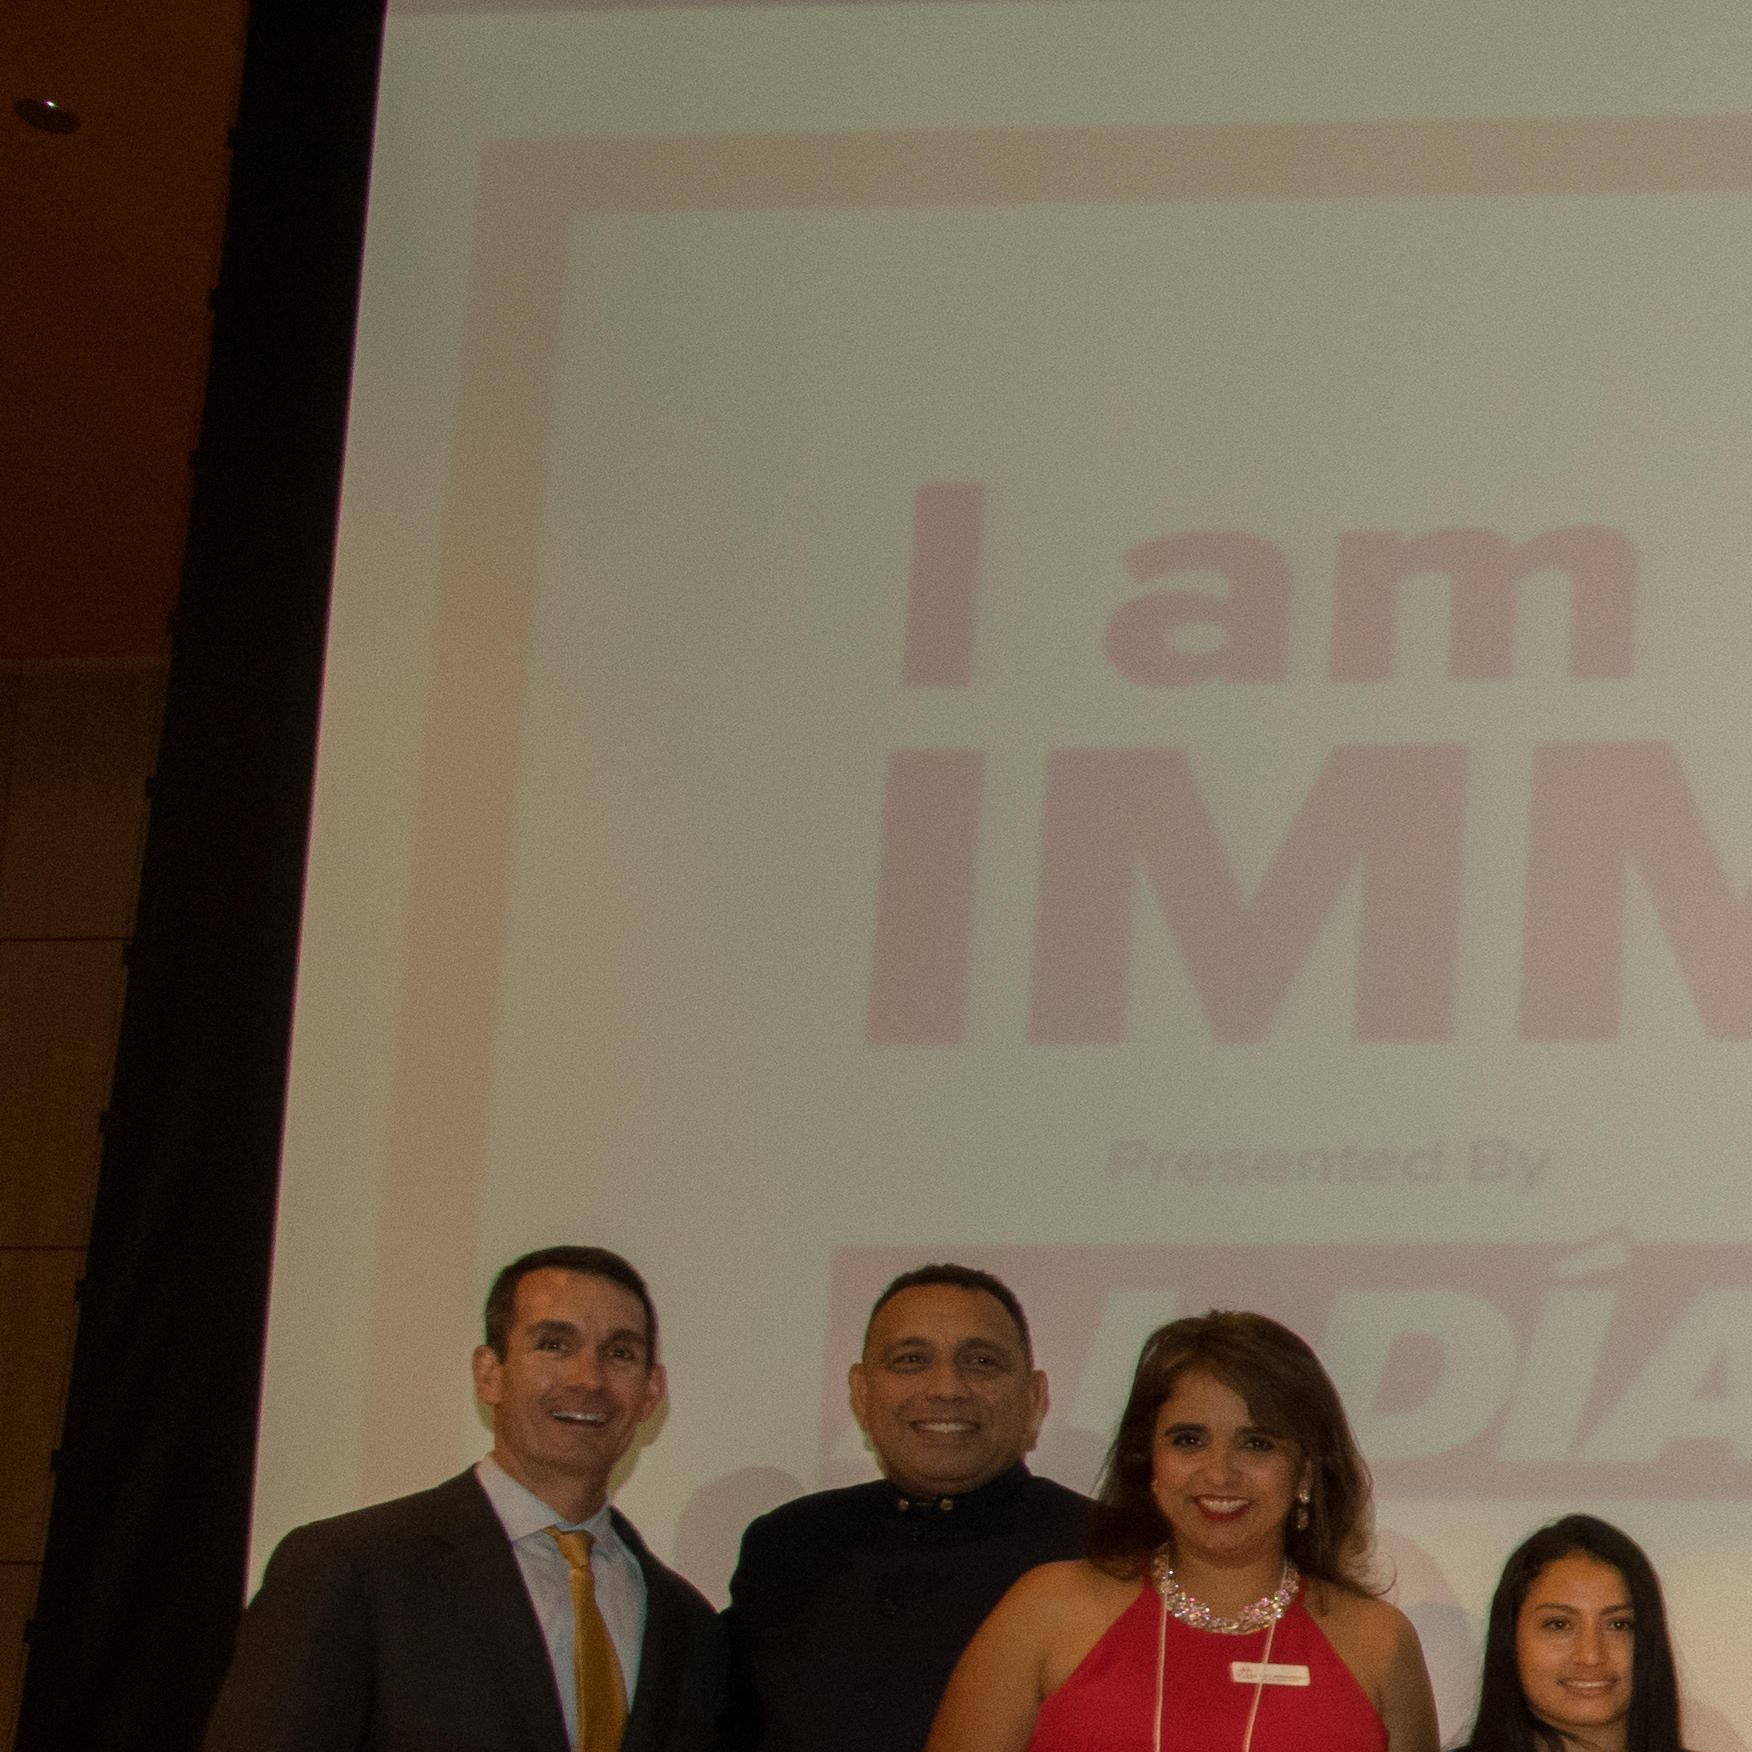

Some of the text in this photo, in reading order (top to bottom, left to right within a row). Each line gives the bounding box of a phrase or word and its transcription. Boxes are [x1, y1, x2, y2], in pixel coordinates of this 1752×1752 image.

[902, 481, 988, 688] I
[1102, 522, 1642, 689] am
[1106, 1135, 1554, 1196] Presented By
